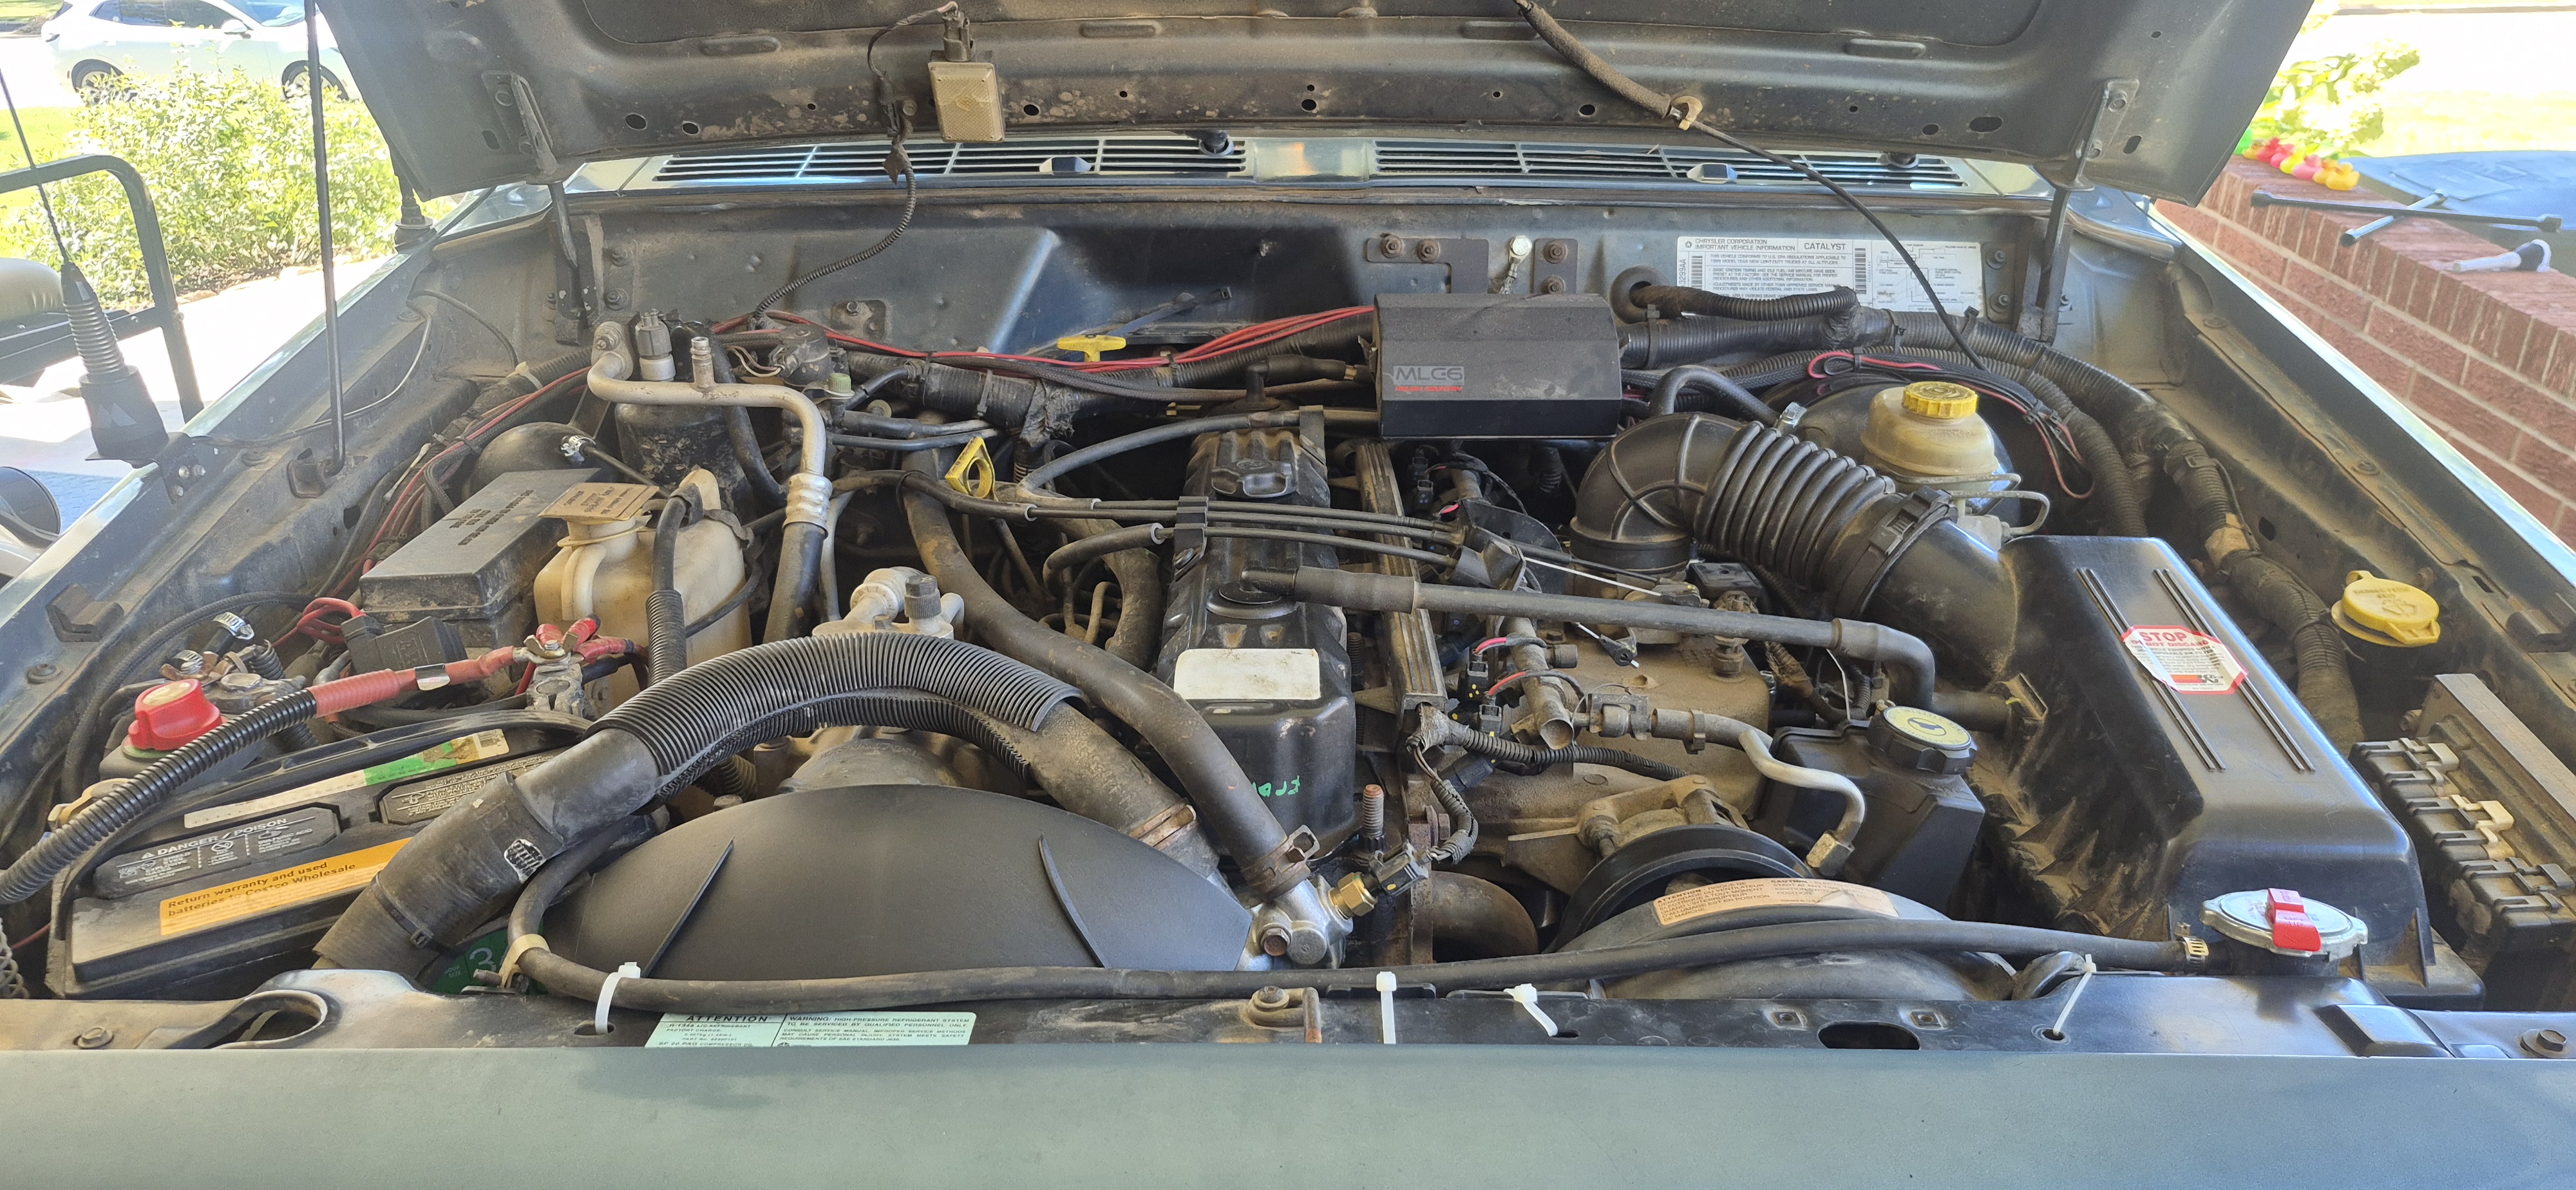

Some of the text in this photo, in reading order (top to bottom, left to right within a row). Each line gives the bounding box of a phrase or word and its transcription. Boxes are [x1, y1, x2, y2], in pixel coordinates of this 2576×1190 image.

[2139, 632, 2187, 641] STOP
[157, 836, 219, 855] DANGER
[234, 818, 287, 836] POISON
[169, 862, 327, 908] Return warranty and used
[169, 897, 225, 916] batteries
[245, 882, 289, 896] Costco
[292, 864, 355, 883] Wholesale
[1715, 883, 1764, 892] VENTILATEUR
[1657, 889, 1701, 903] ATTENTION
[1661, 903, 1685, 914] QUAND
